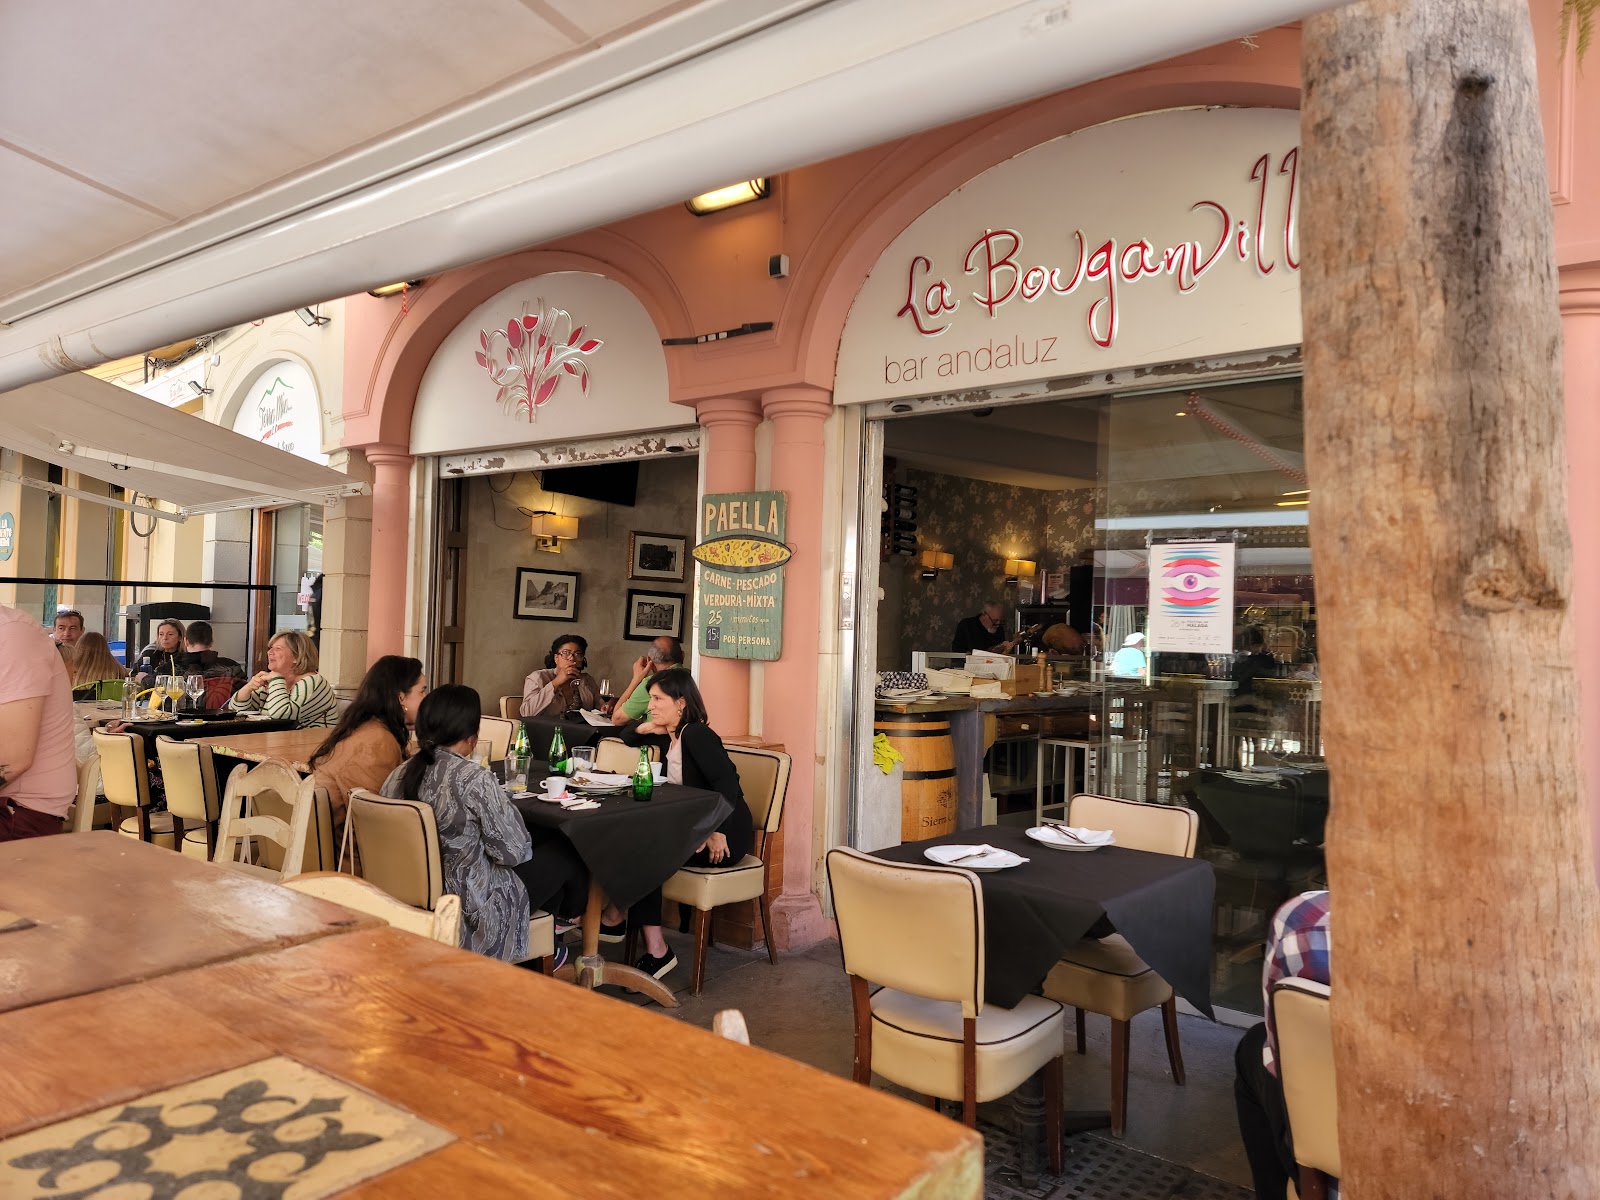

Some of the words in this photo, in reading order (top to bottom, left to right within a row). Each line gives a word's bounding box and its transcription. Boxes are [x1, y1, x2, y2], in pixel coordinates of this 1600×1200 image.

[897, 255, 960, 337] La
[964, 146, 1300, 348] Bouganvill
[884, 354, 928, 385] bar
[937, 334, 1058, 378] andaluz
[705, 500, 779, 536] PAELLA
[708, 609, 723, 625] 25
[722, 634, 736, 644] POR
[738, 635, 771, 646] PERSONA
